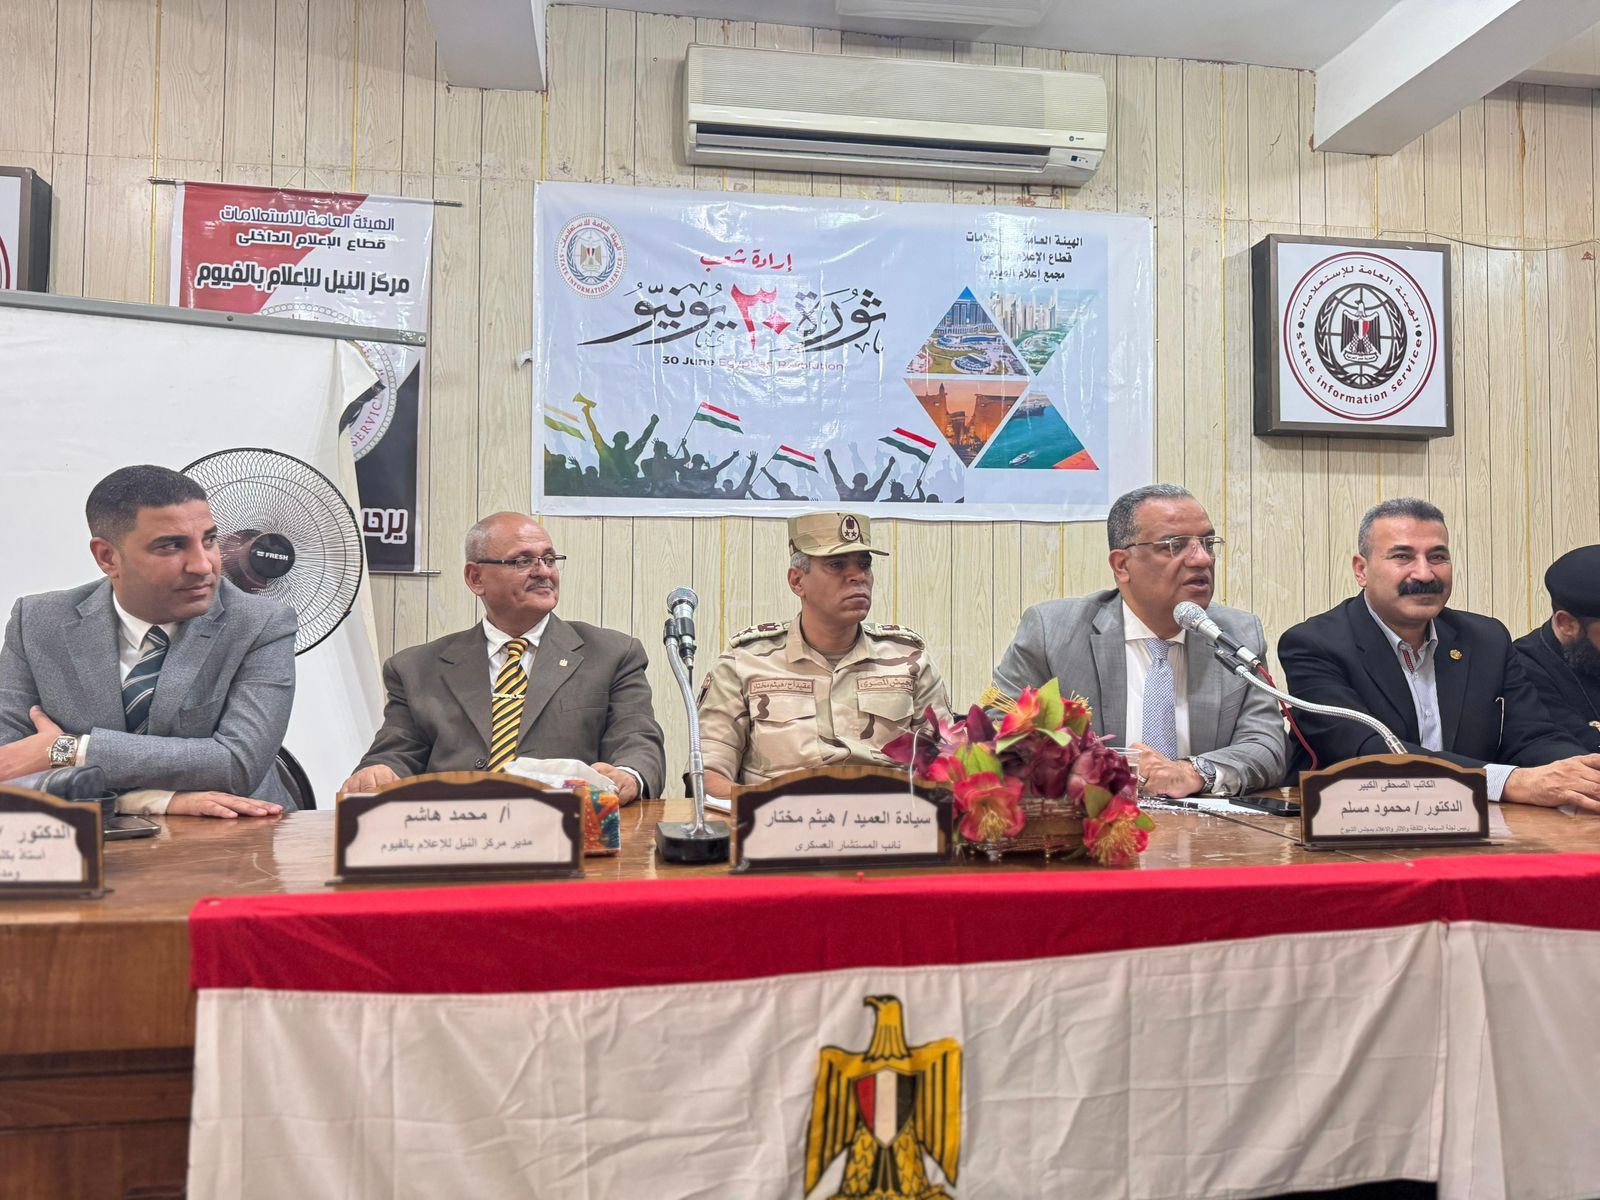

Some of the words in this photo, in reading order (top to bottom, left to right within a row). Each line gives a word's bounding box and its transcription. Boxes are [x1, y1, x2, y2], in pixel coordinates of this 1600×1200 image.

[220, 206, 304, 227] للاستعلامات
[306, 212, 350, 229] العامة
[353, 216, 395, 232] الهيئة
[295, 235, 342, 249] الإعلام
[347, 238, 386, 252] قطاع
[751, 249, 793, 273] إرادة
[1048, 252, 1072, 265] قطاع
[196, 262, 265, 291] بالفيوم
[266, 266, 322, 293] للإعلام
[324, 270, 365, 293] النيل
[560, 254, 569, 276] STATE
[568, 275, 610, 294] INFORMATION
[610, 258, 623, 283] SERVICE
[1018, 268, 1041, 282] إعلام
[1043, 271, 1065, 283] مجمع
[1358, 265, 1394, 286] العامة
[368, 273, 410, 297] مركز
[662, 355, 680, 365] 30
[682, 357, 715, 367] June
[1316, 375, 1389, 405] information
[1391, 340, 1423, 393] service
[351, 397, 384, 447] SERVIC
[265, 552, 289, 561] FRESH
[1358, 780, 1379, 791] الكبير
[1413, 779, 1436, 791] الكاتب
[449, 810, 488, 822] محمد
[1341, 801, 1370, 818] مسلم
[1374, 803, 1411, 817] محمود
[1424, 800, 1463, 817] الدكتور
[403, 806, 441, 829] هاشم
[765, 809, 803, 828] مختار
[808, 808, 836, 830] هيثم
[853, 810, 889, 828] العميد
[895, 811, 931, 829] سيادة
[16, 824, 71, 844] الدكتور
[380, 838, 414, 853] بالفيوم
[455, 837, 477, 851] النيل
[481, 837, 507, 851] مركز
[511, 838, 533, 850] مدير
[837, 839, 879, 852] المستشار
